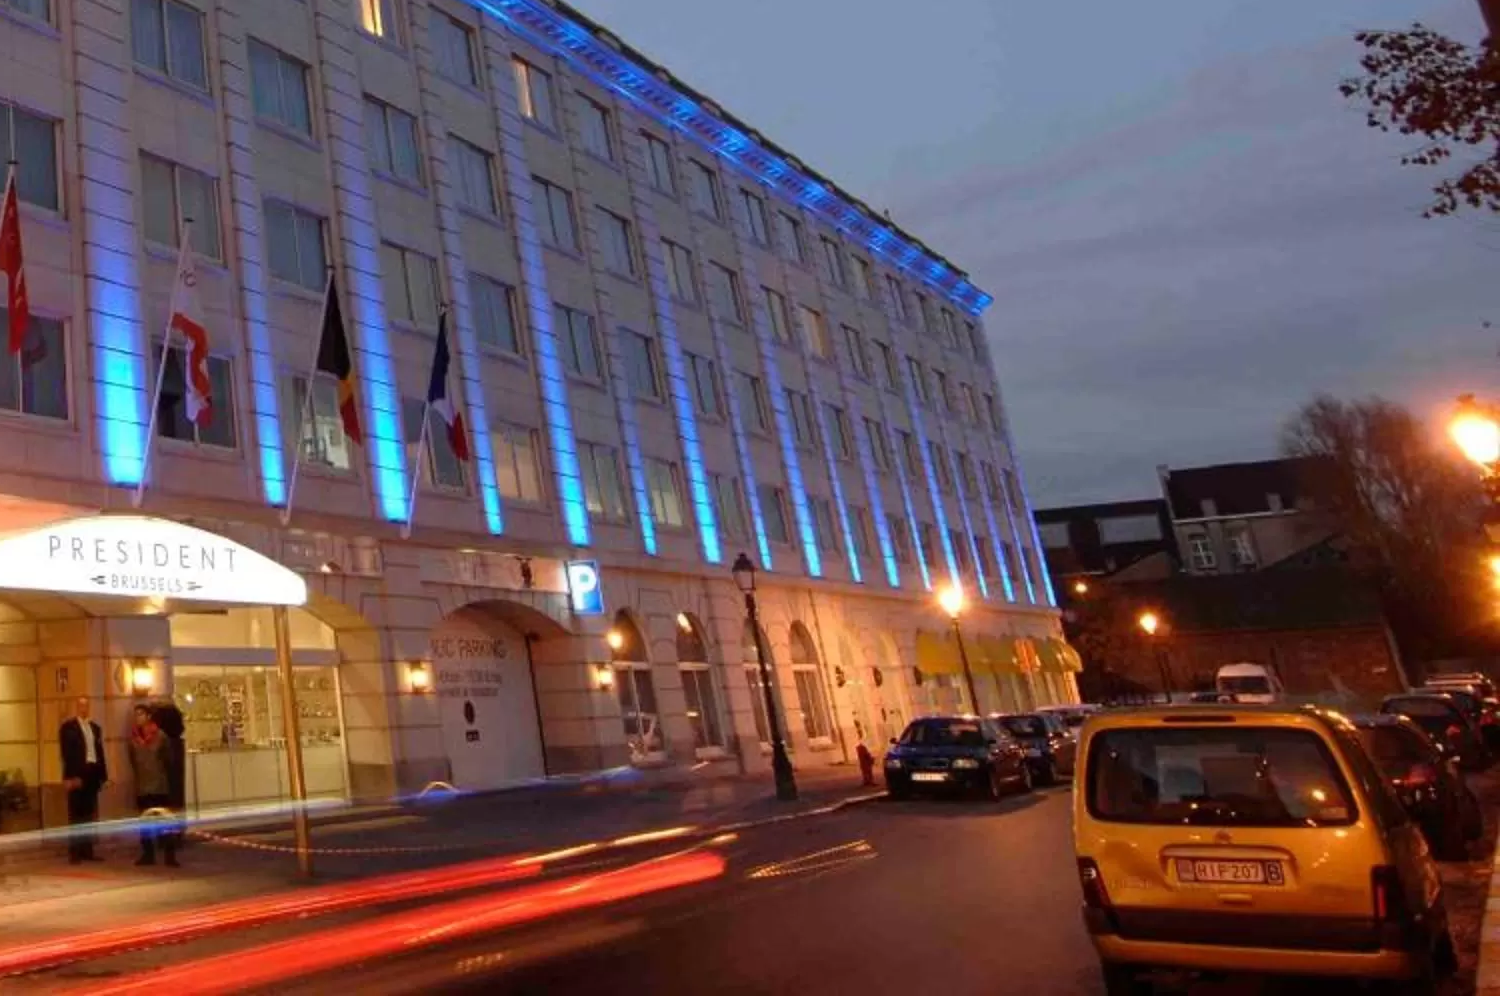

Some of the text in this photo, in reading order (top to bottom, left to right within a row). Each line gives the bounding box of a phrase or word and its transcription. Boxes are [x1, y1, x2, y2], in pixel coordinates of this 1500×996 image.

[48, 534, 237, 572] PRESIDENT
[110, 573, 184, 593] BRUSSELS
[569, 564, 598, 611] P
